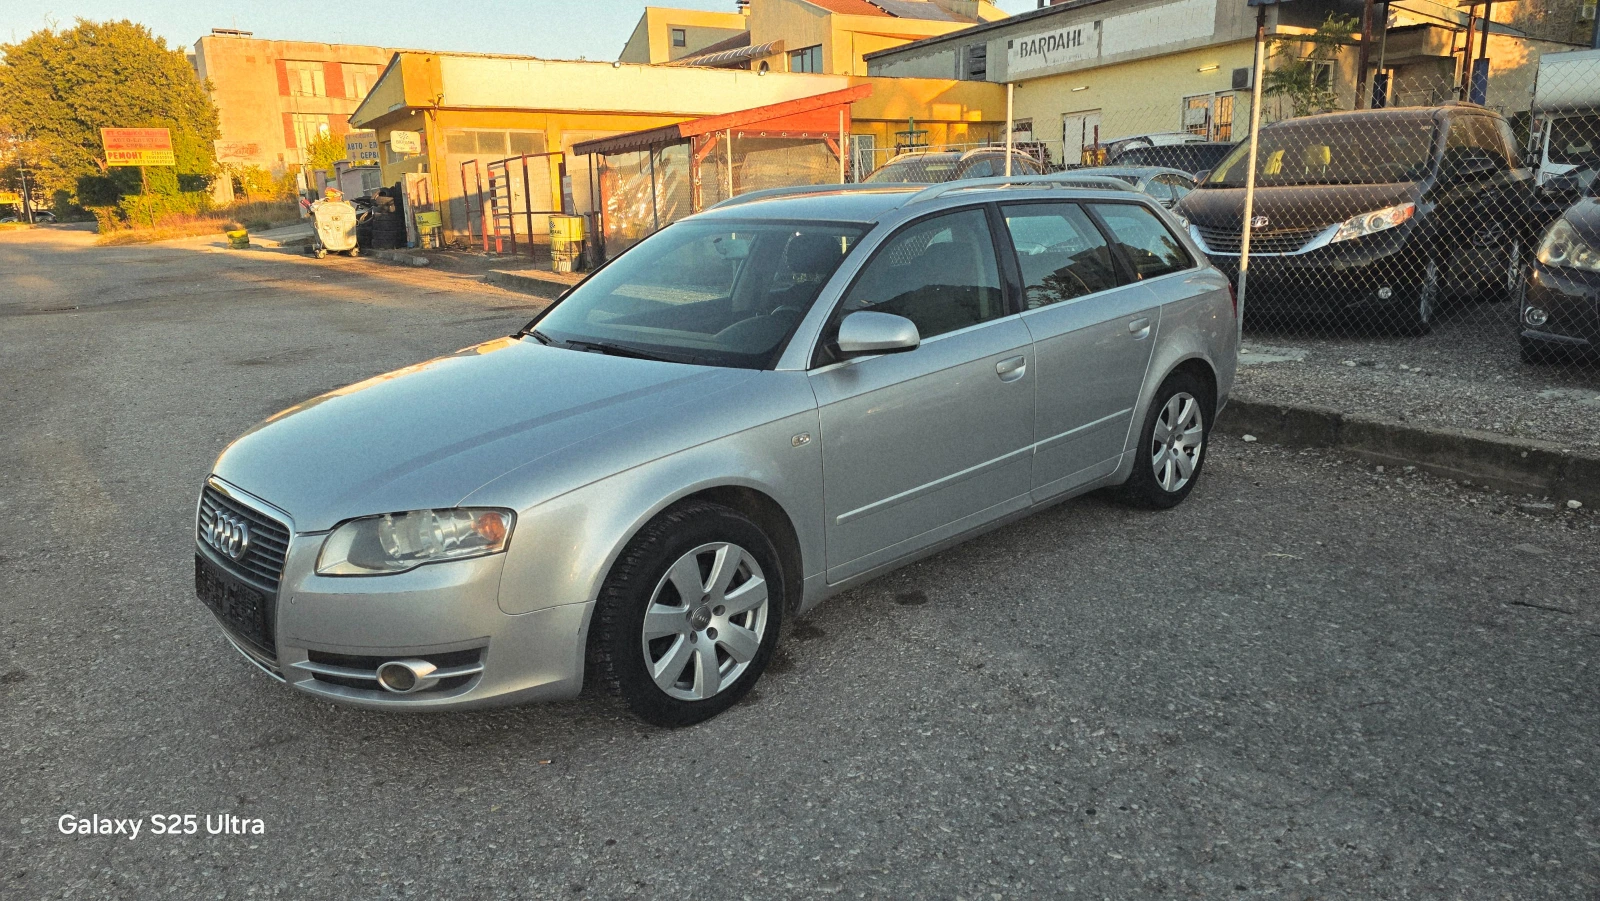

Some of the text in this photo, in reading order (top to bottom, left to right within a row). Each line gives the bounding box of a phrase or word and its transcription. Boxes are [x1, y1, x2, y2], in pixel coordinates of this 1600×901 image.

[1020, 29, 1084, 64] BARDAHL
[347, 142, 363, 150] АВТО
[107, 151, 143, 160] РЕМОНТ
